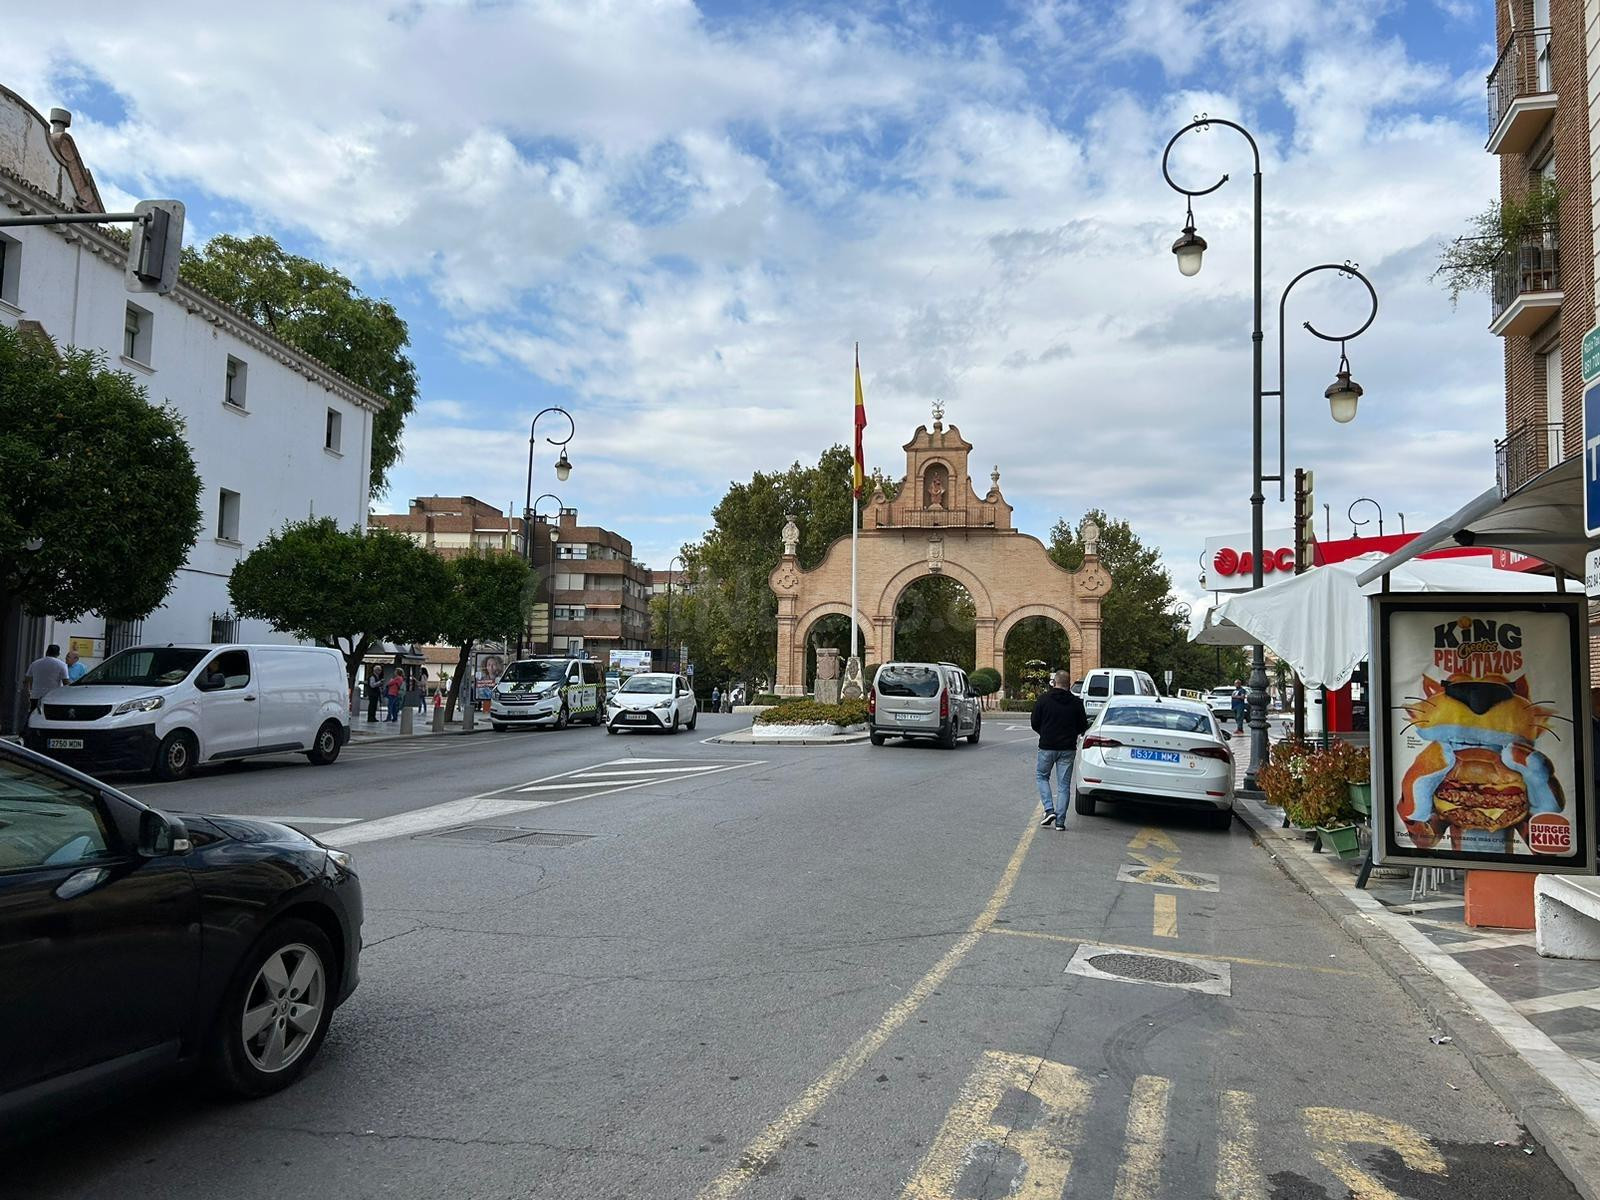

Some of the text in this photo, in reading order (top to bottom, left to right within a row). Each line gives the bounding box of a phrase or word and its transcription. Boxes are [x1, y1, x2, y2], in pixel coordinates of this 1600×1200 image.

[1458, 640, 1498, 659] Cheetos
[1434, 650, 1523, 678] PELOTAZOS
[1136, 750, 1158, 760] 5371
[1531, 824, 1570, 835] BURGER
[1531, 833, 1571, 846] KING
